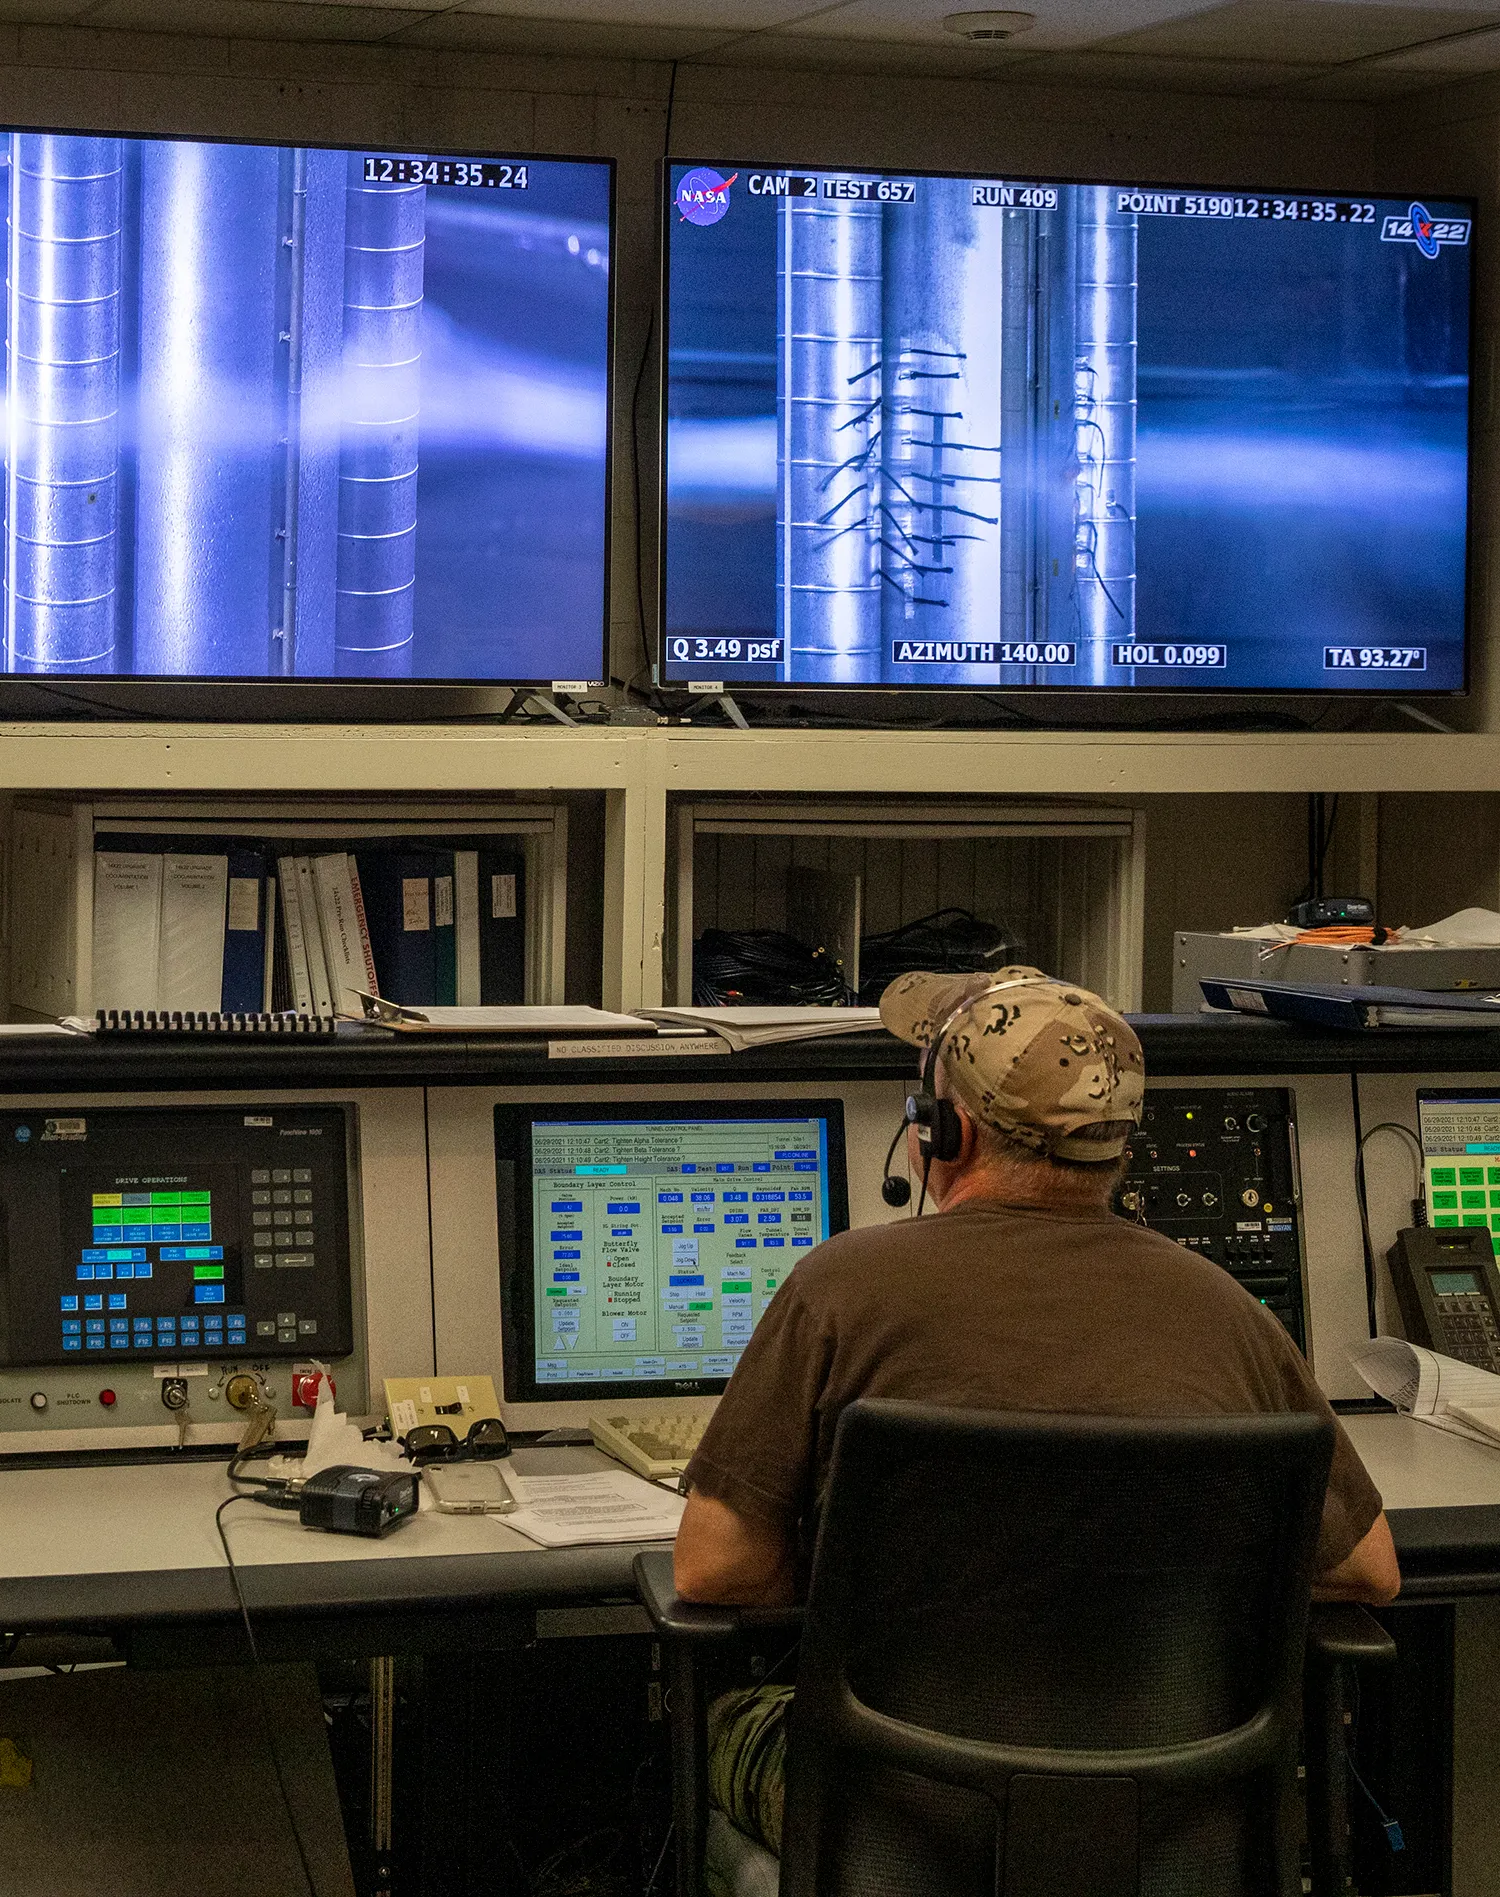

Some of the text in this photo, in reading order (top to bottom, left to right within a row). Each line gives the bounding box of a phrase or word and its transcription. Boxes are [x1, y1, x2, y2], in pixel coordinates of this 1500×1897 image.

[365, 158, 528, 188] 12:34:35.24
[748, 174, 816, 196] CAM 2
[824, 179, 915, 202] TEST 657
[681, 189, 727, 204] NASA
[972, 187, 1057, 209] RUN 409
[1118, 193, 1232, 217] POINT 5190
[1234, 198, 1376, 223] 12:34:35.22
[673, 639, 780, 661] Q 3.49 psf
[898, 642, 1070, 663] AZIMUTH 140.00
[1118, 645, 1220, 665] HOL 0.099
[1329, 648, 1356, 667] TA
[339, 930, 350, 964] Checklists
[351, 876, 378, 998] EMERGENCY SHUTOFFS
[571, 1045, 622, 1053] CLASSIFIED
[626, 1043, 675, 1052] DISCUSSION
[679, 1042, 719, 1050] ANYWHERE
[612, 1137, 633, 1145] Tighten
[613, 1146, 633, 1154] Tighten
[252, 1364, 270, 1372] OFF
[675, 1382, 700, 1390] DELL
